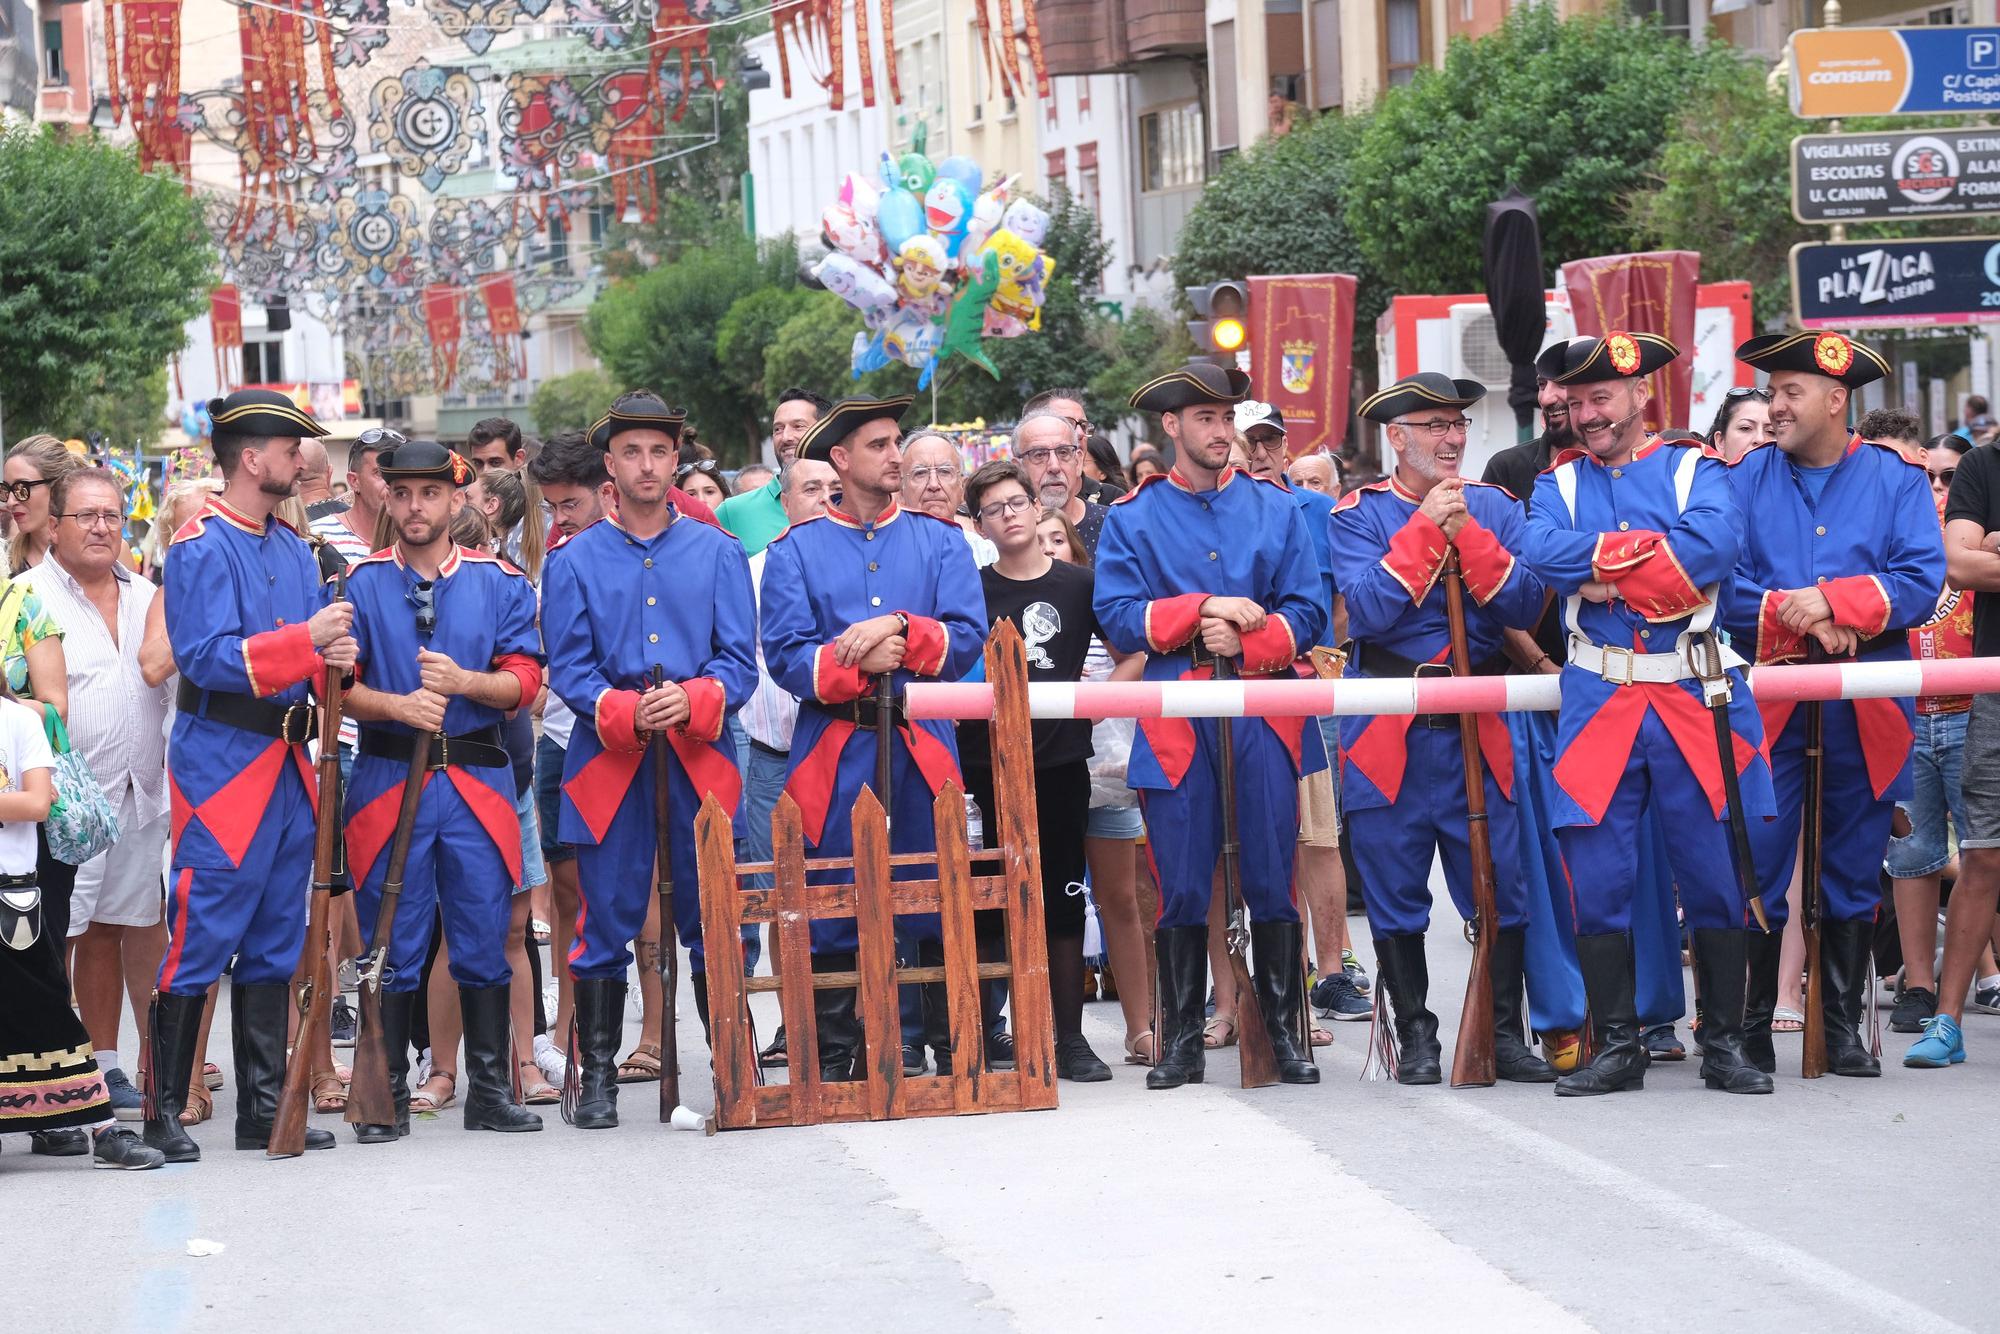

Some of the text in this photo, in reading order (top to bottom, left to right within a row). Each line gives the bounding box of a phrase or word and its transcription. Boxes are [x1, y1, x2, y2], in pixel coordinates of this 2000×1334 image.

[1973, 41, 1993, 62] P
[1808, 69, 1892, 84] consum
[1943, 73, 2000, 89] C/ Capi
[1802, 143, 1891, 159] VIGILANTES
[1810, 165, 1885, 180] ESCOLTAS
[1809, 186, 1888, 203] U. CANINA
[1818, 249, 1935, 304] PLAZICA
